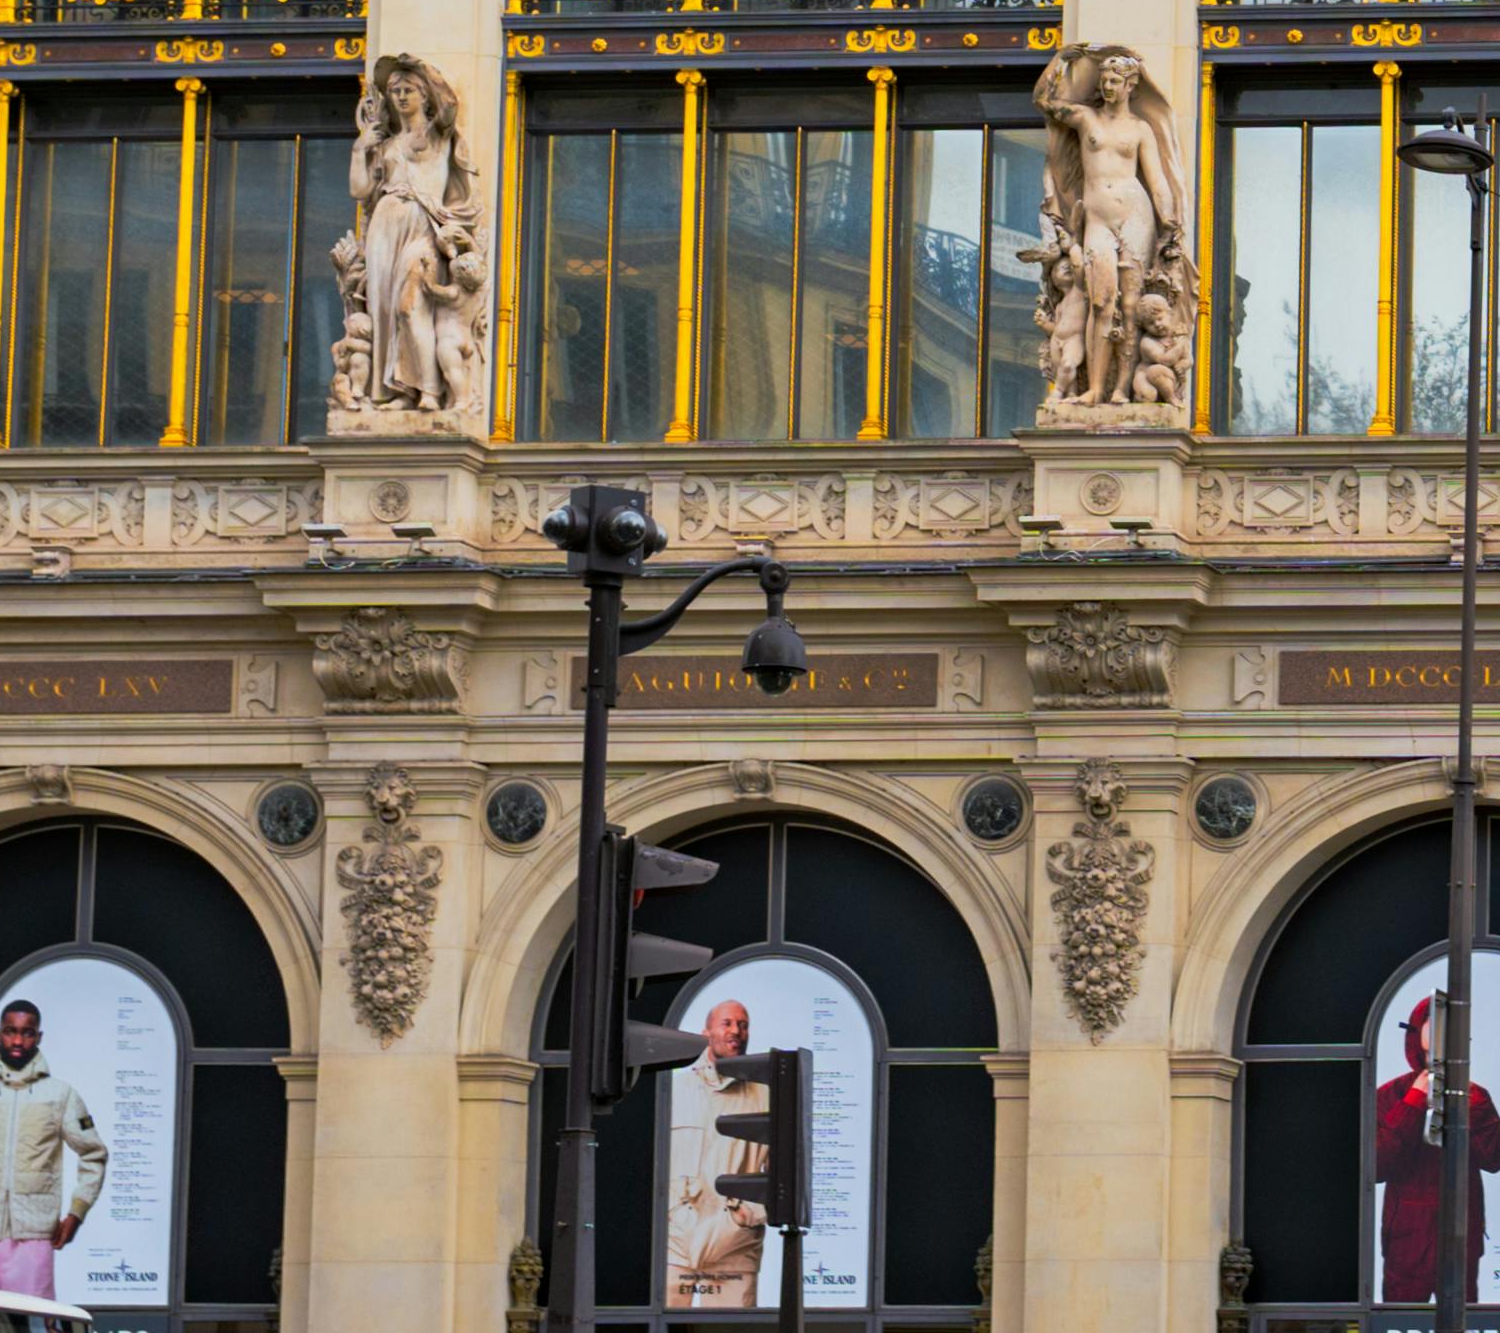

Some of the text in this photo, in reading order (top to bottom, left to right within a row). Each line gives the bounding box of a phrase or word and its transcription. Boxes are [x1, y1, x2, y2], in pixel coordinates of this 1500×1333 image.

[86, 1271, 159, 1282] STONE ISLAND
[822, 1274, 857, 1285] ISLAND
[678, 1282, 715, 1295] ÉTAGE
